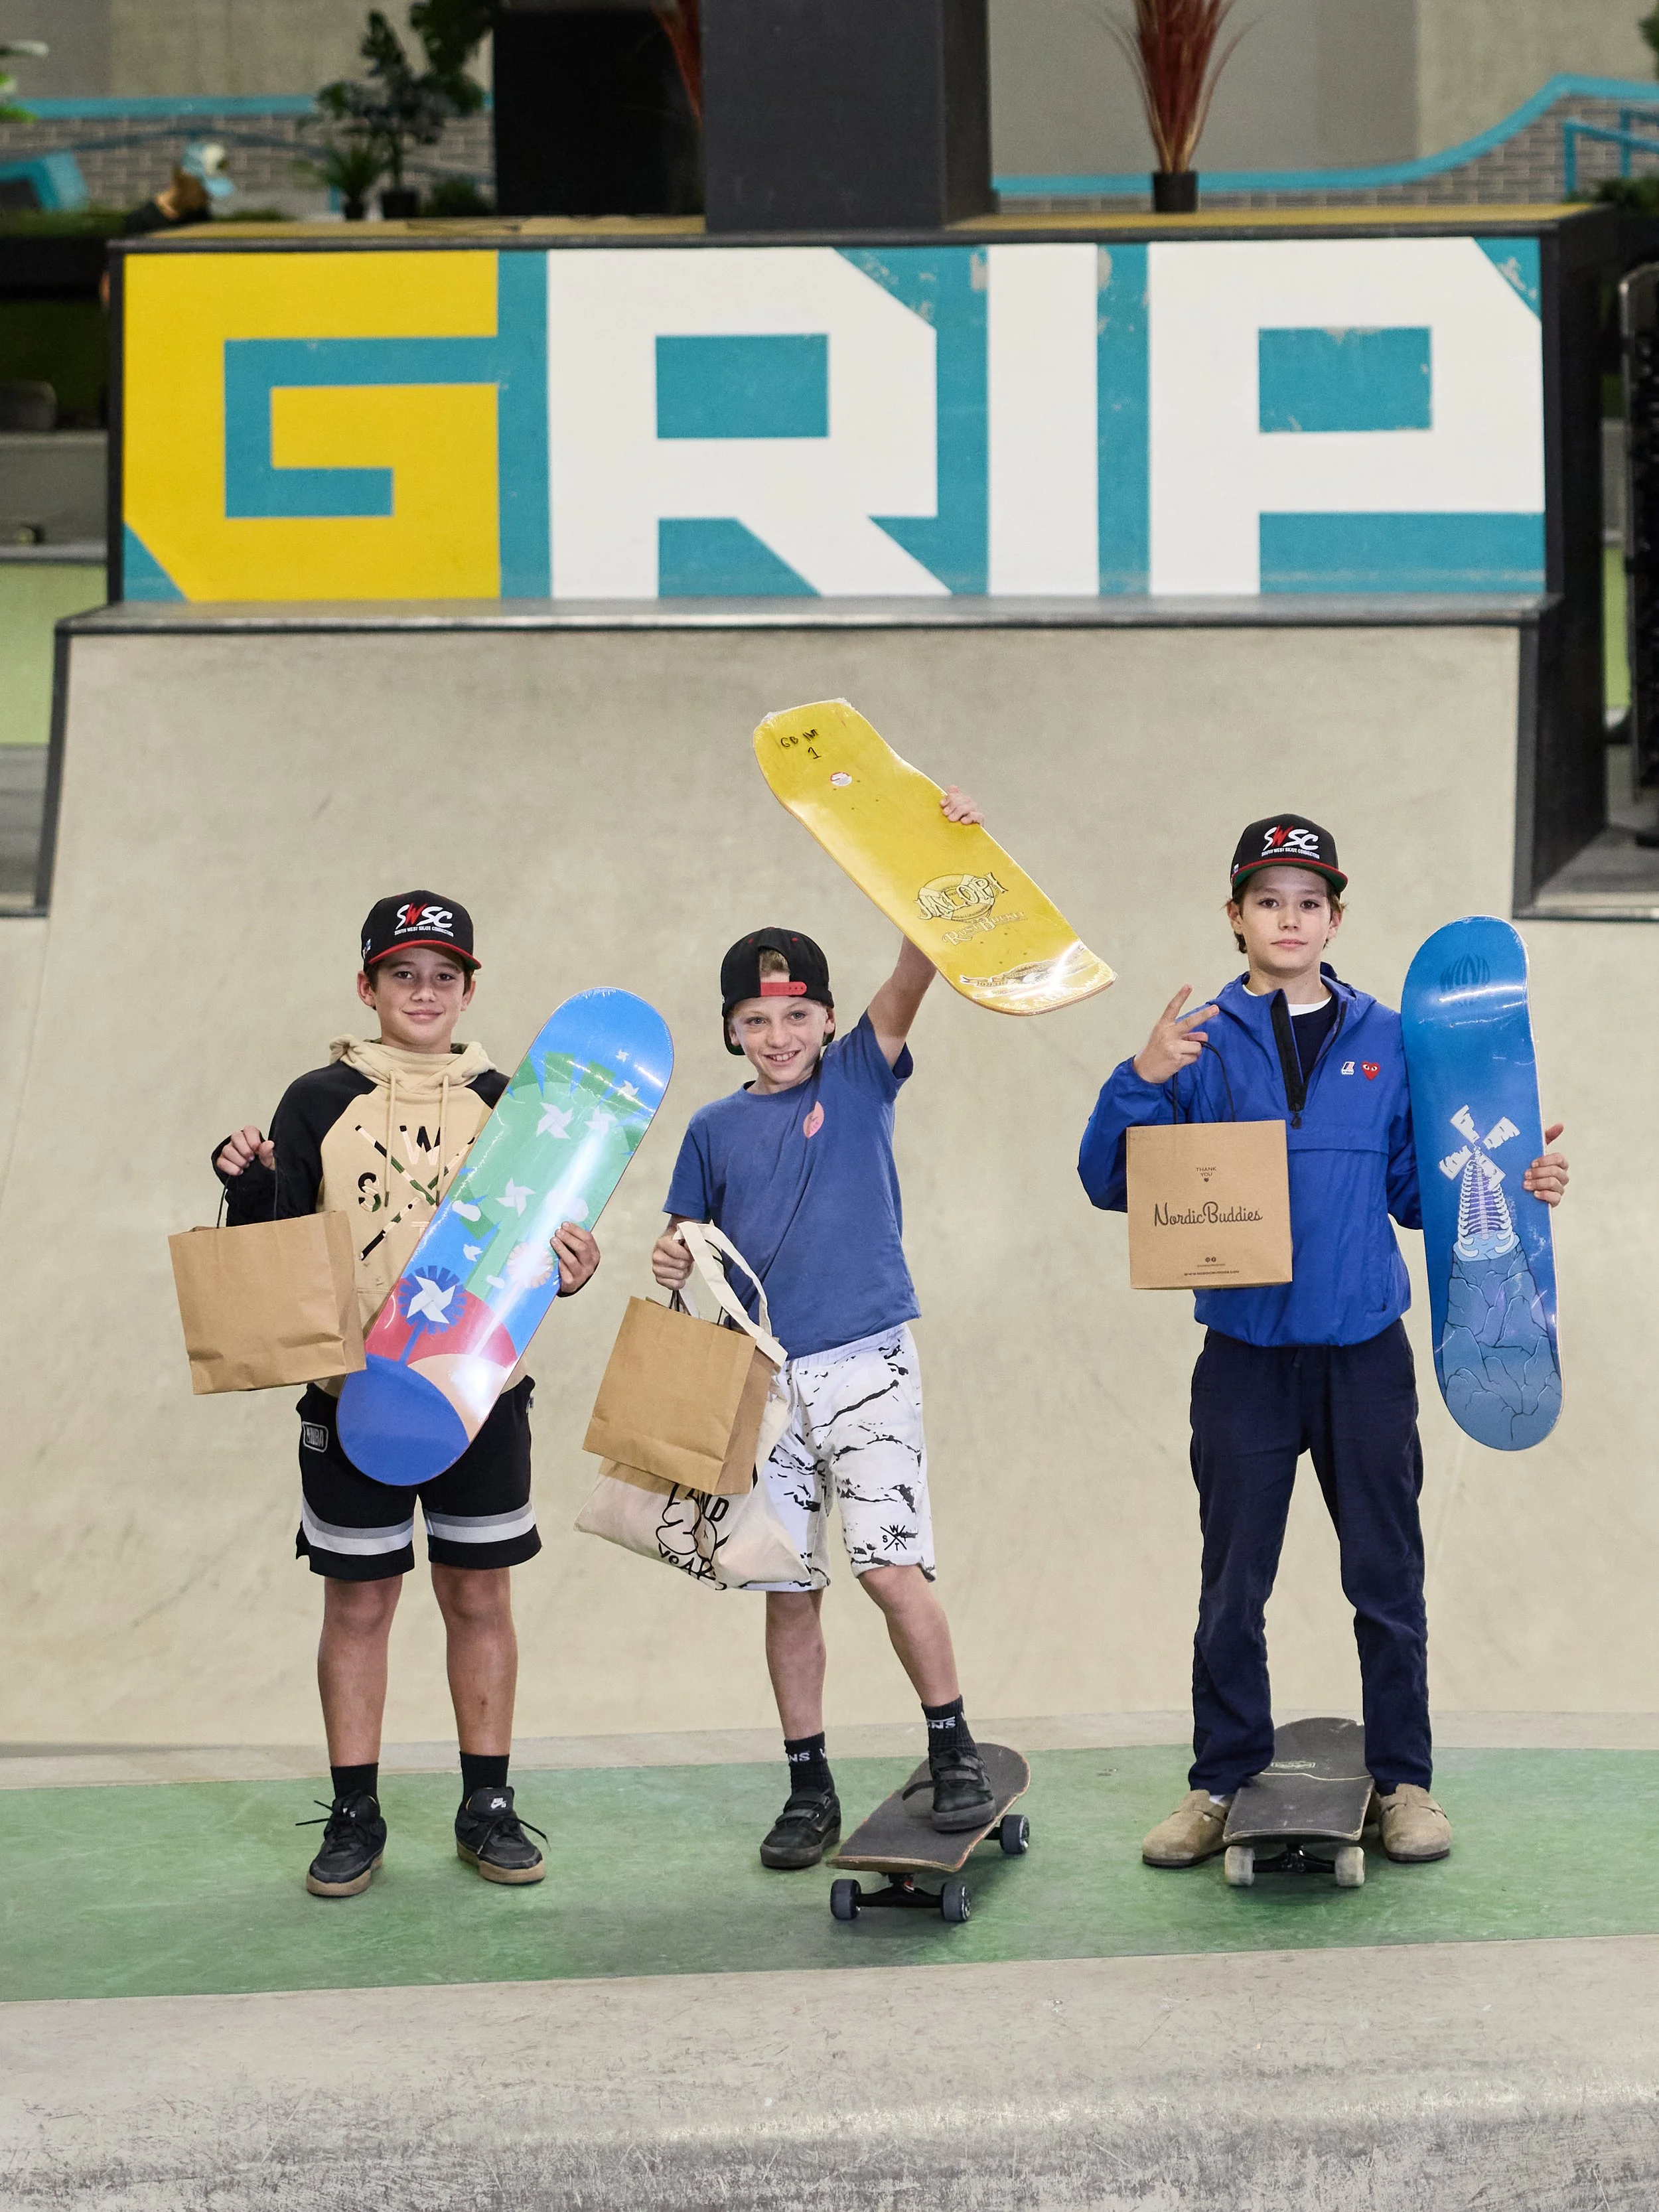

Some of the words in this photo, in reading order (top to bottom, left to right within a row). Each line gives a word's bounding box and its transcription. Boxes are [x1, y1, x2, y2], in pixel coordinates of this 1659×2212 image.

[123, 239, 1545, 601] GRIP
[1263, 825, 1319, 851] SWSC
[396, 903, 453, 930] SWSC
